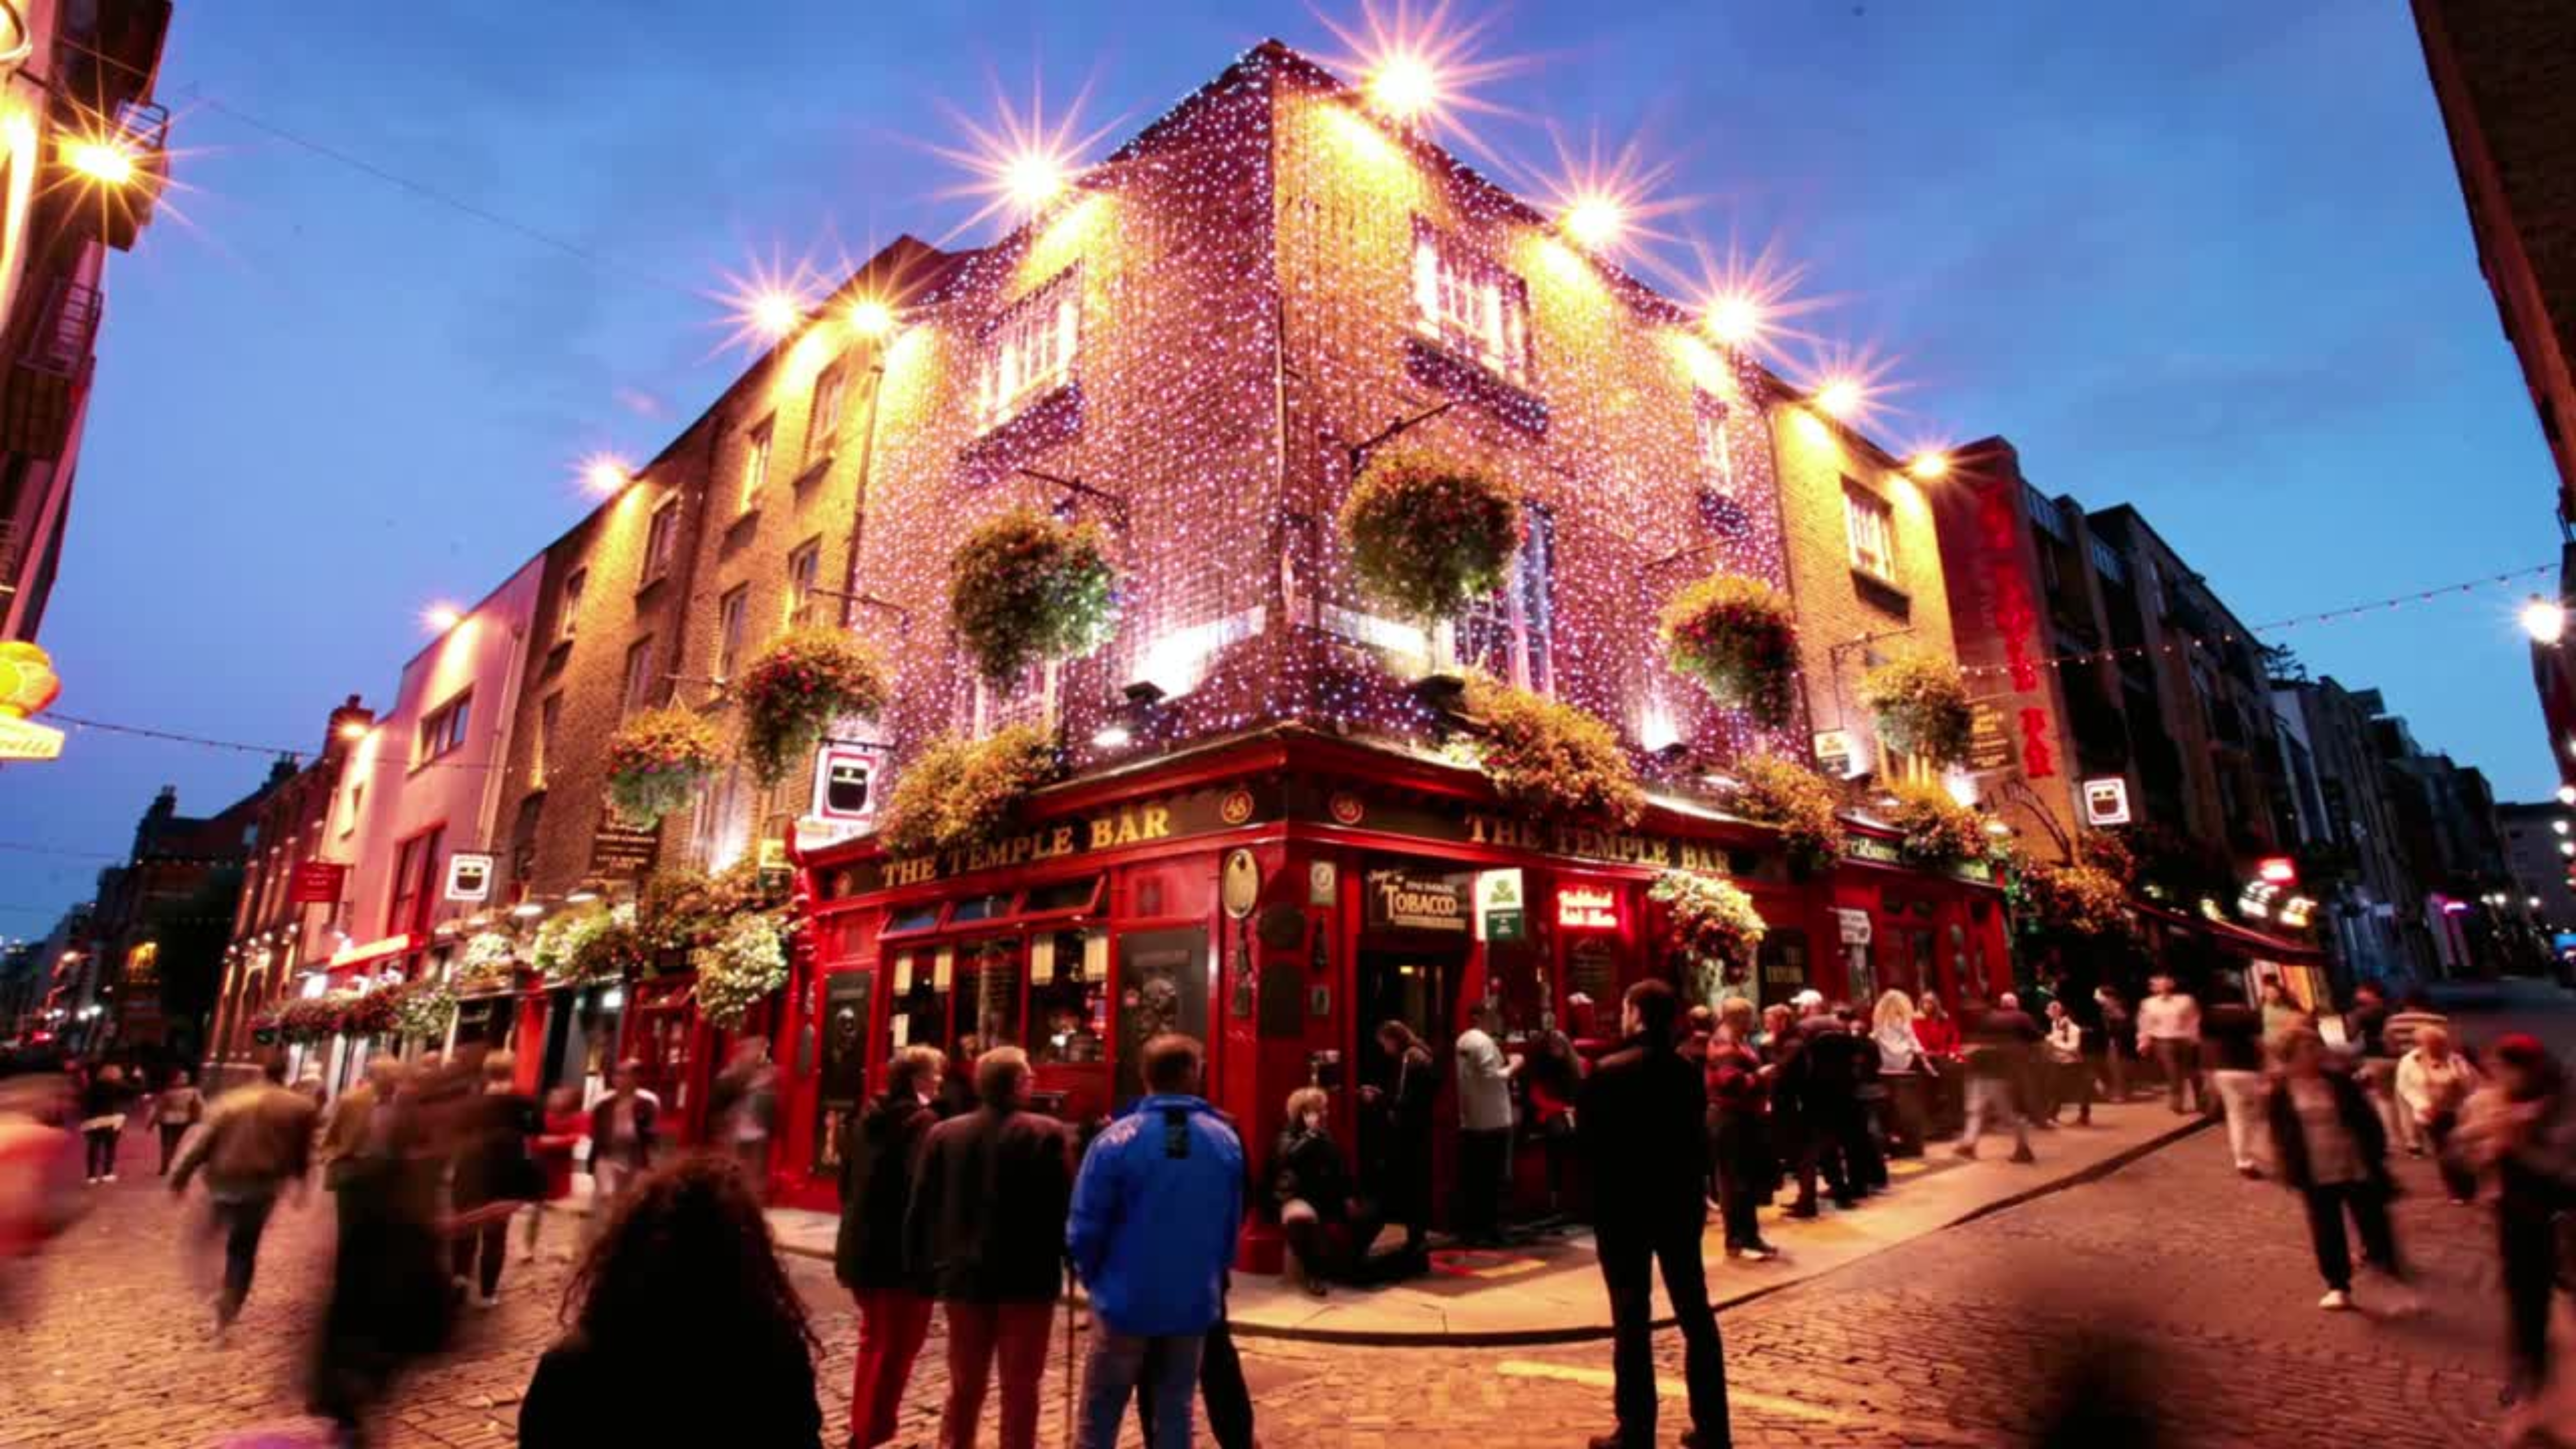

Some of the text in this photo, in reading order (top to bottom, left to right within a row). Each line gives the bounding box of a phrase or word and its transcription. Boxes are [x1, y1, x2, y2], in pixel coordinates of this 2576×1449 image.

[882, 806, 1170, 887] THE TEMPLE BAR
[1465, 814, 1731, 875] THE TEMPLE BAR
[1384, 884, 1457, 920] TOBACCO
